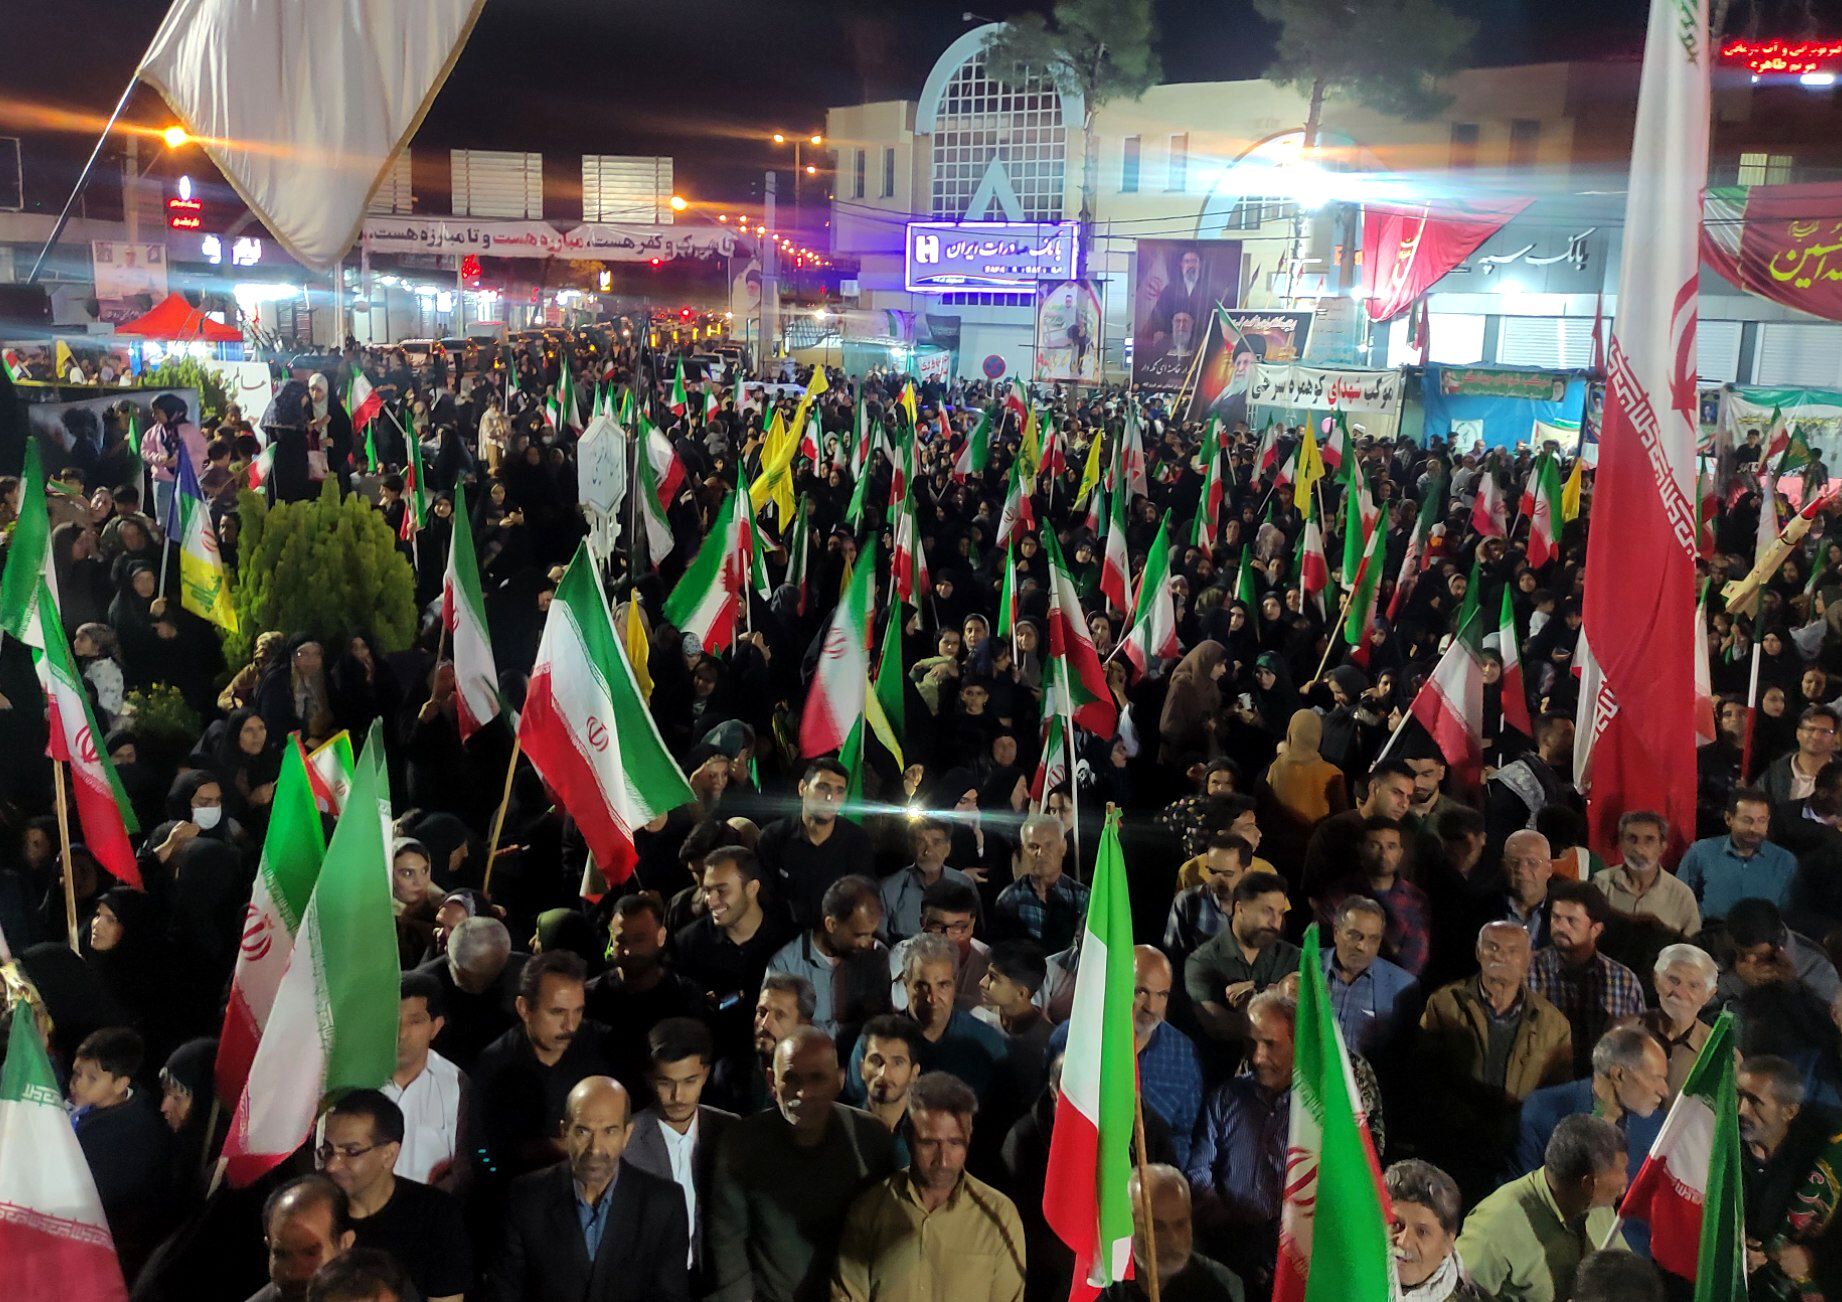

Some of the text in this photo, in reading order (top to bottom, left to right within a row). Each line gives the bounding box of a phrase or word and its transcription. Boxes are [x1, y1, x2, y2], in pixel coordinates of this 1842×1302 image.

[421, 229, 465, 247] مبارزه
[467, 228, 480, 243] تا
[482, 235, 491, 249] و
[493, 233, 538, 246] هست
[637, 234, 663, 254] کفر
[946, 240, 979, 260] ایران
[1029, 230, 1064, 262] بانک
[1478, 227, 1597, 275] بانک سپه
[1327, 375, 1362, 405] شهدای
[1364, 377, 1393, 409] موکب
